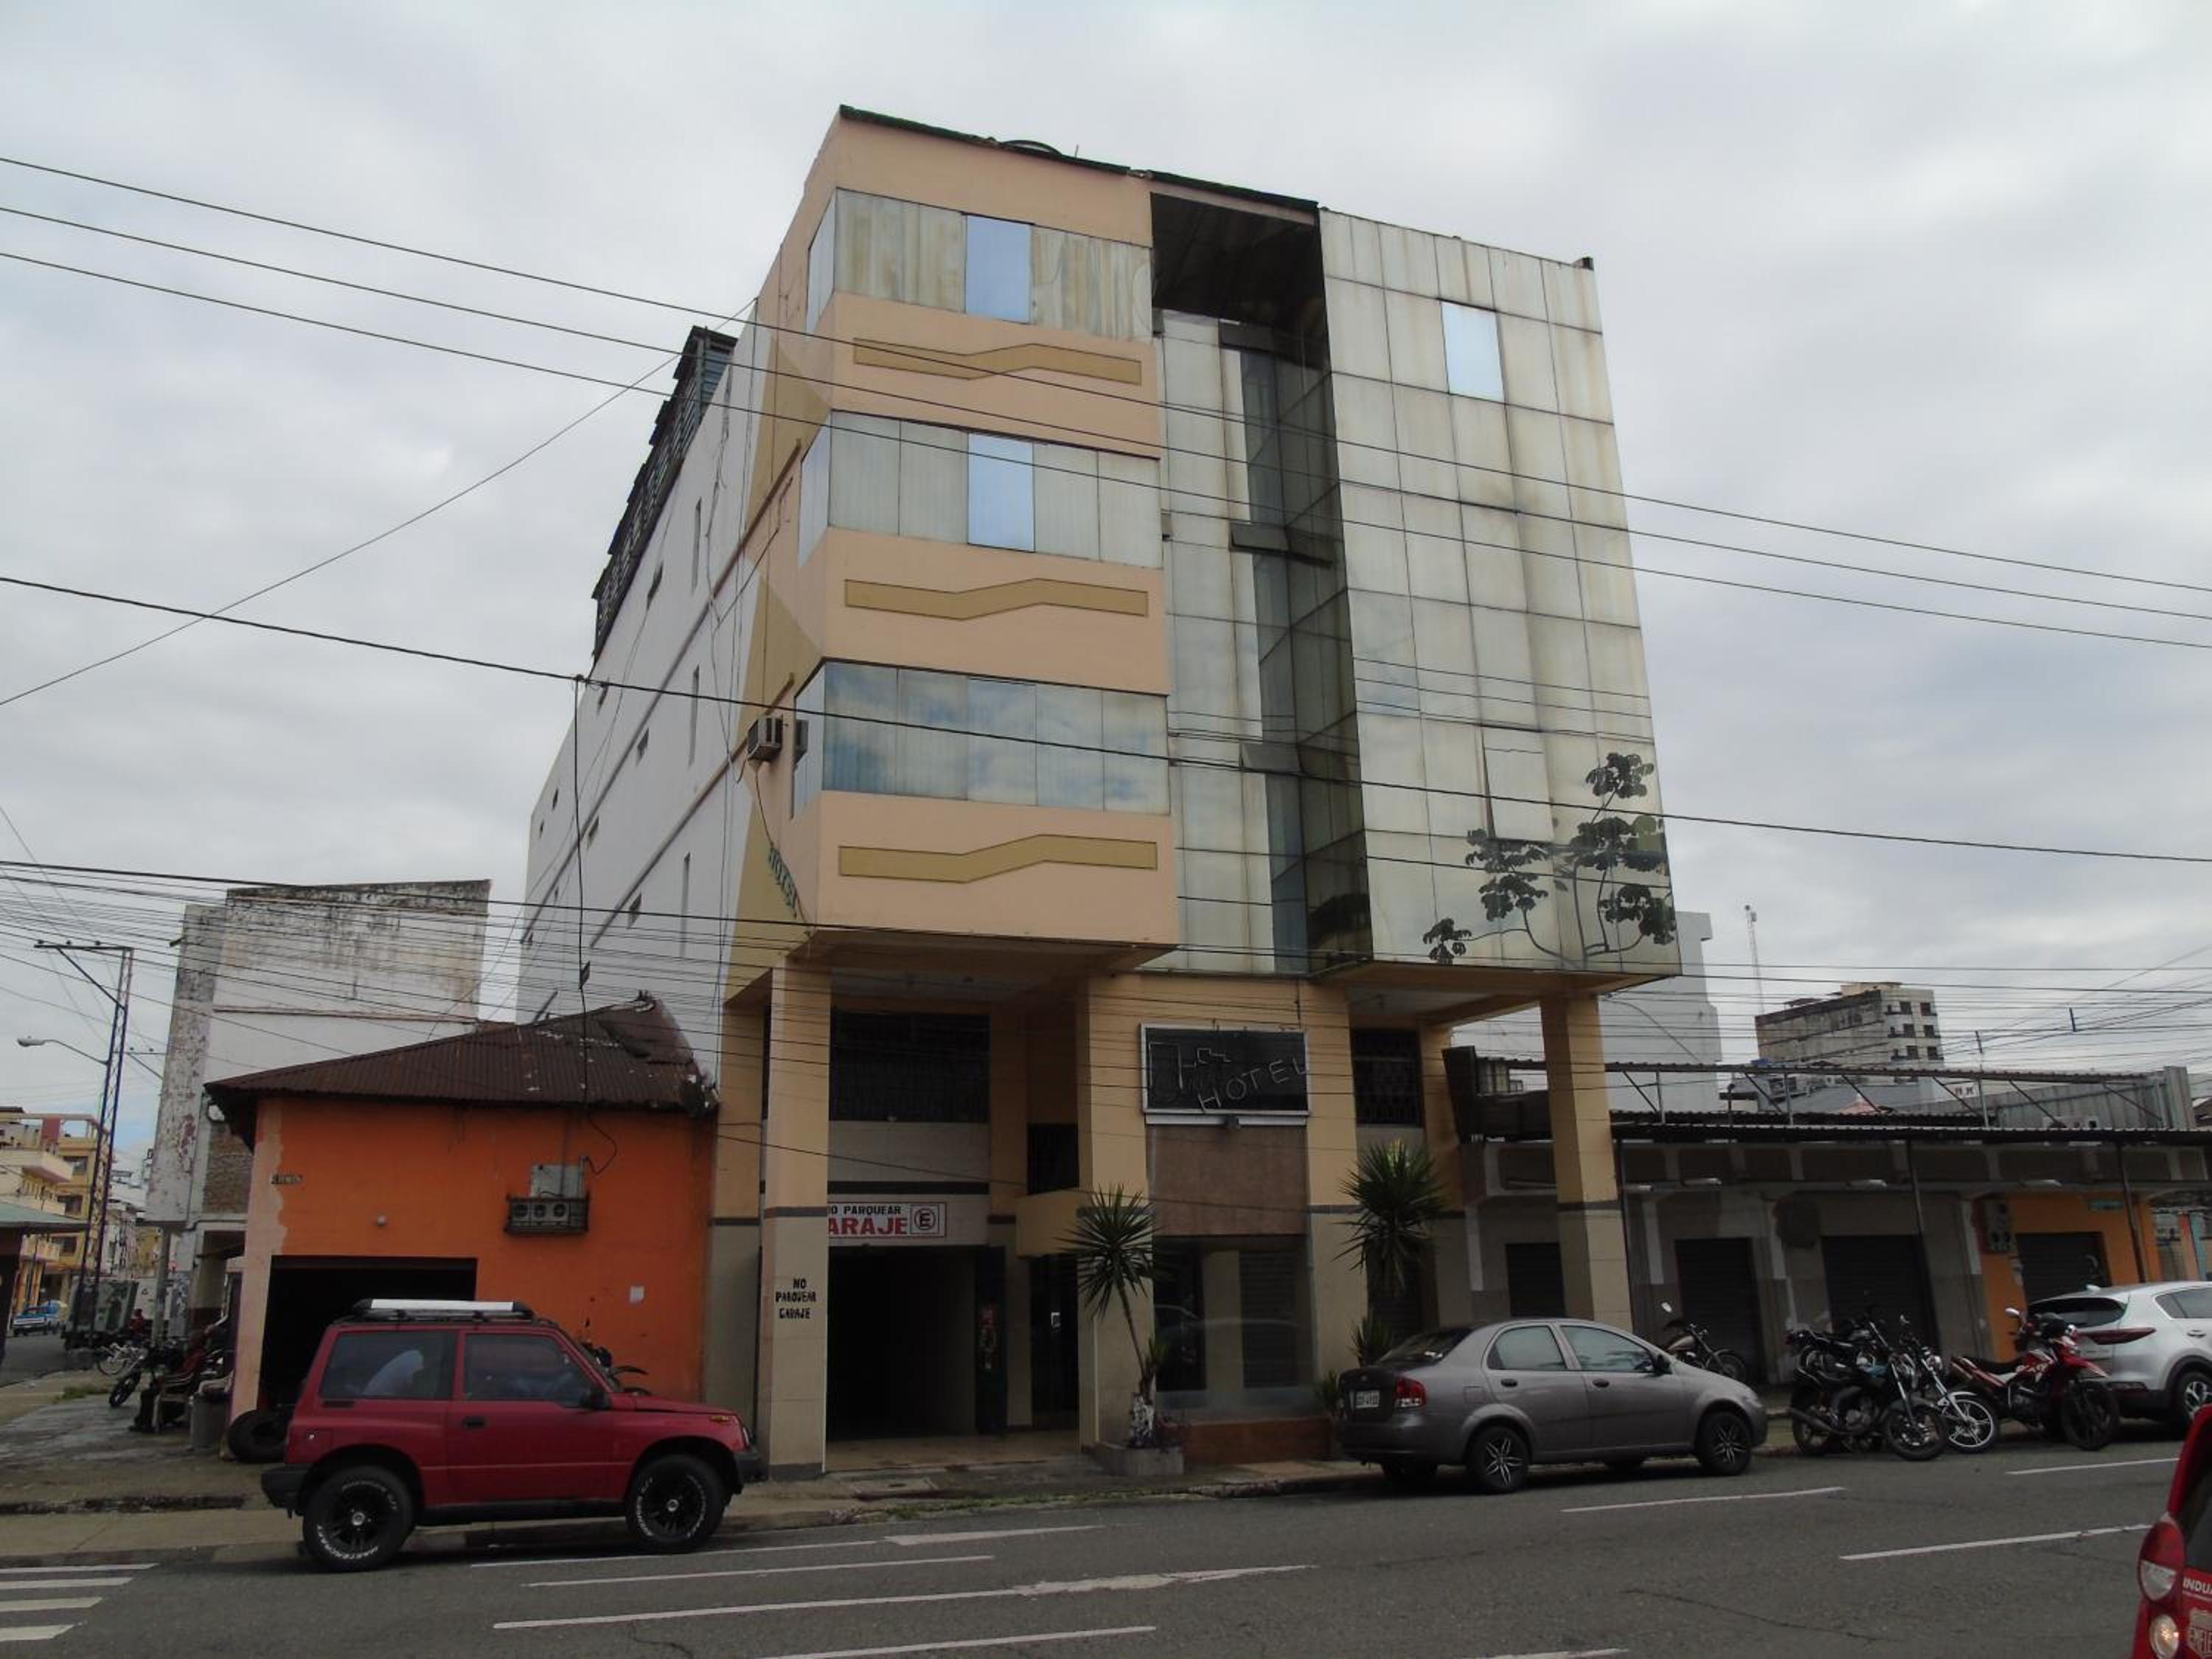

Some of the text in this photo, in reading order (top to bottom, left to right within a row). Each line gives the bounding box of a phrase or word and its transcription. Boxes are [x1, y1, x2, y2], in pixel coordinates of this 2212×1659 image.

[1197, 1056, 1307, 1112] HOTEL
[844, 1206, 902, 1216] PARQUEAR
[828, 1217, 908, 1235] ARAJE
[793, 1278, 807, 1290] NO
[2183, 1577, 2212, 1593] INDU
